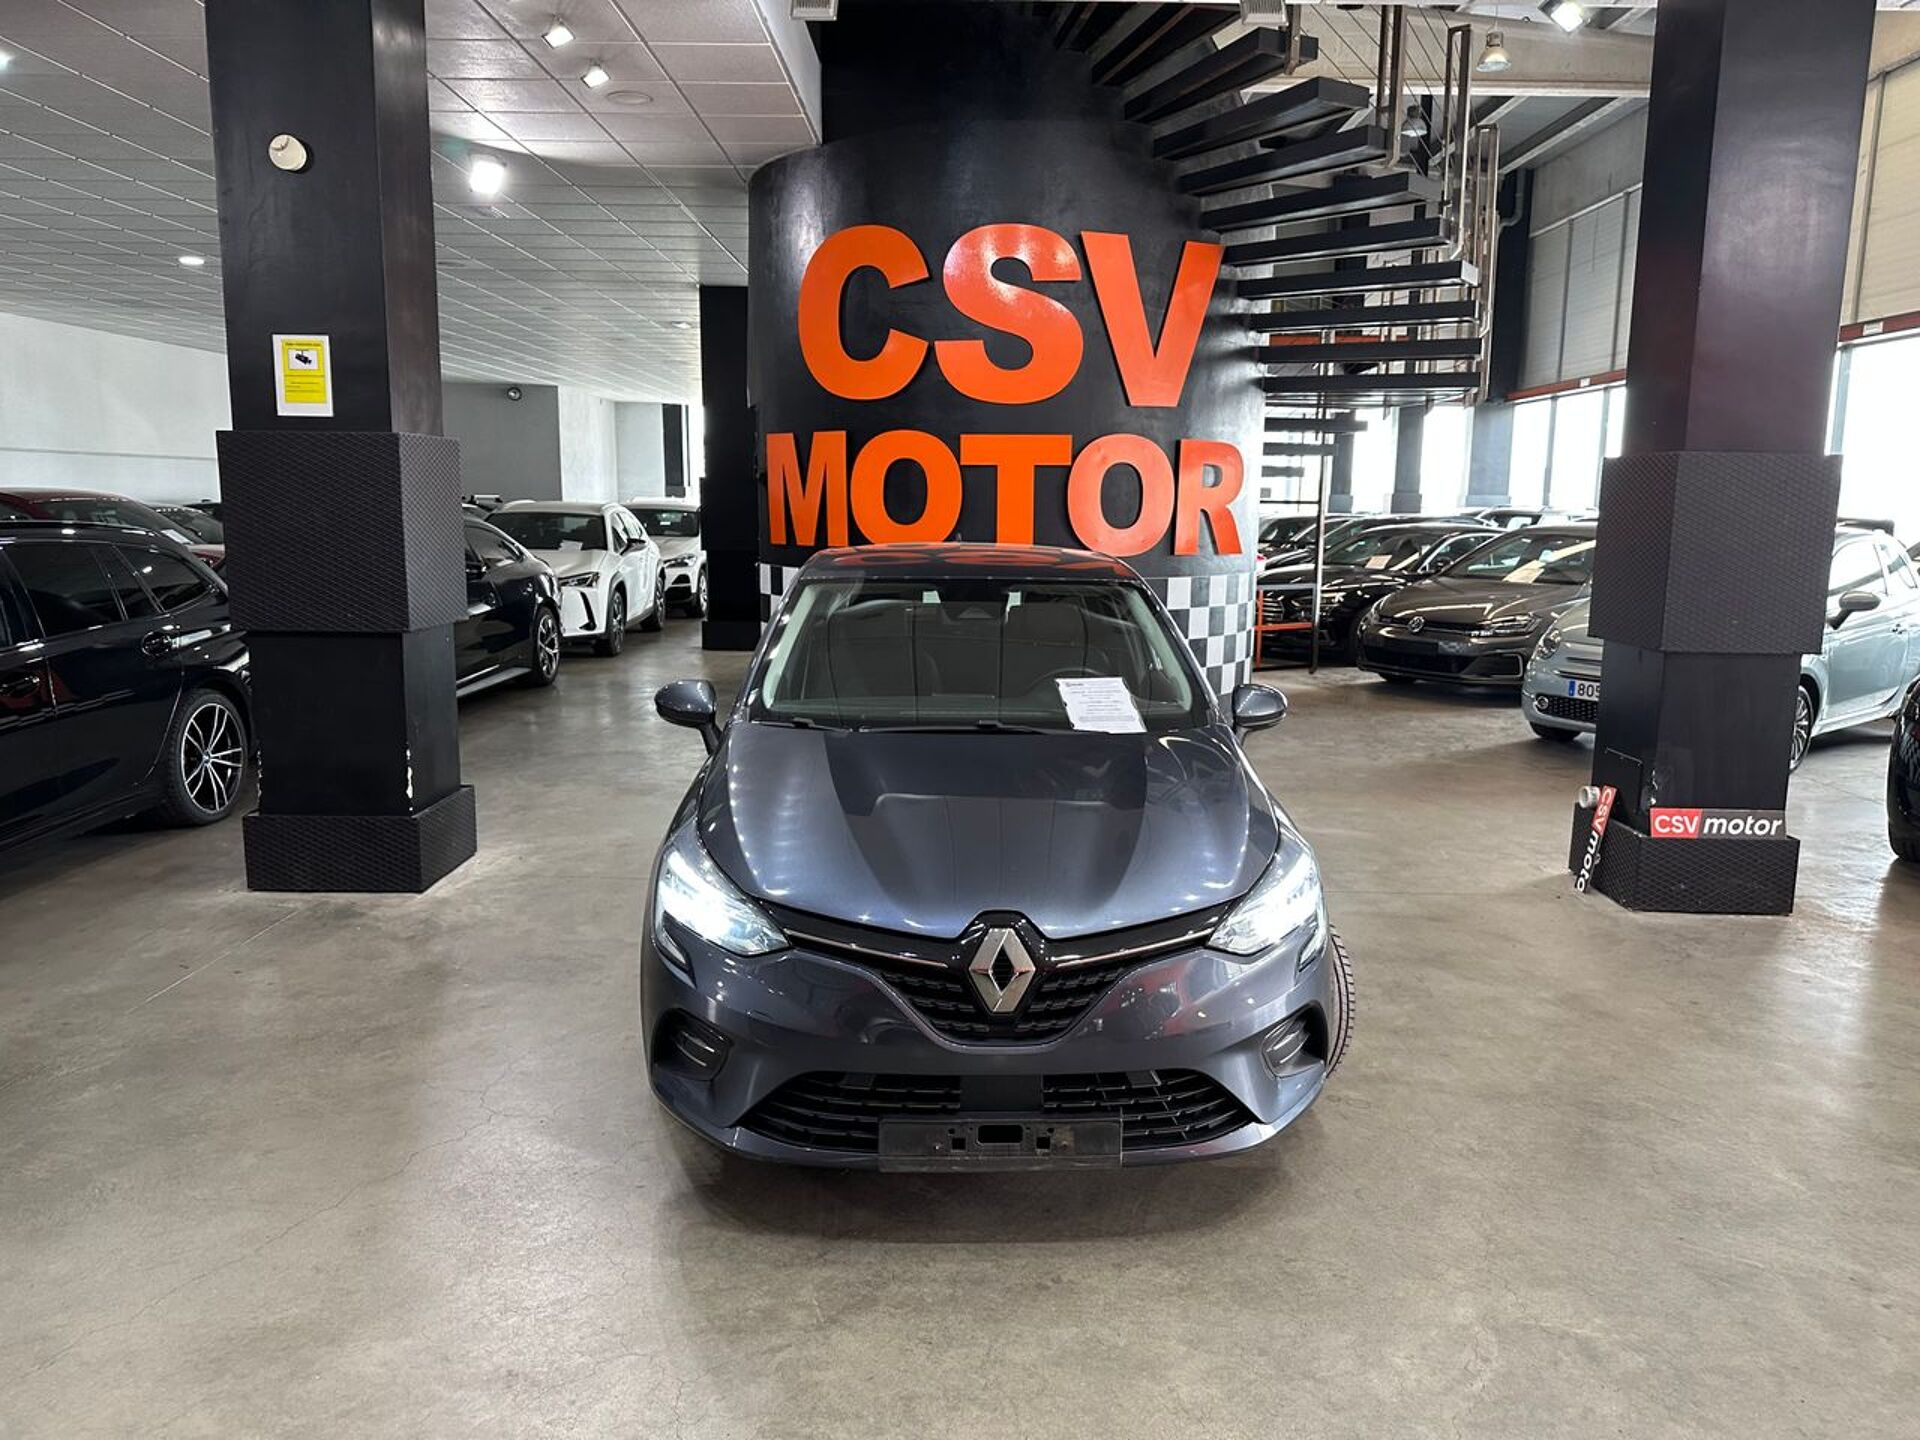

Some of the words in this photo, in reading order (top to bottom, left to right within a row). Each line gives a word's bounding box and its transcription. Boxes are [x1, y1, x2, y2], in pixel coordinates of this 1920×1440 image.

[797, 223, 1224, 408] CSV
[766, 429, 1245, 556] MOTOR
[1654, 815, 1699, 833] CSV
[1703, 815, 1783, 835] motor
